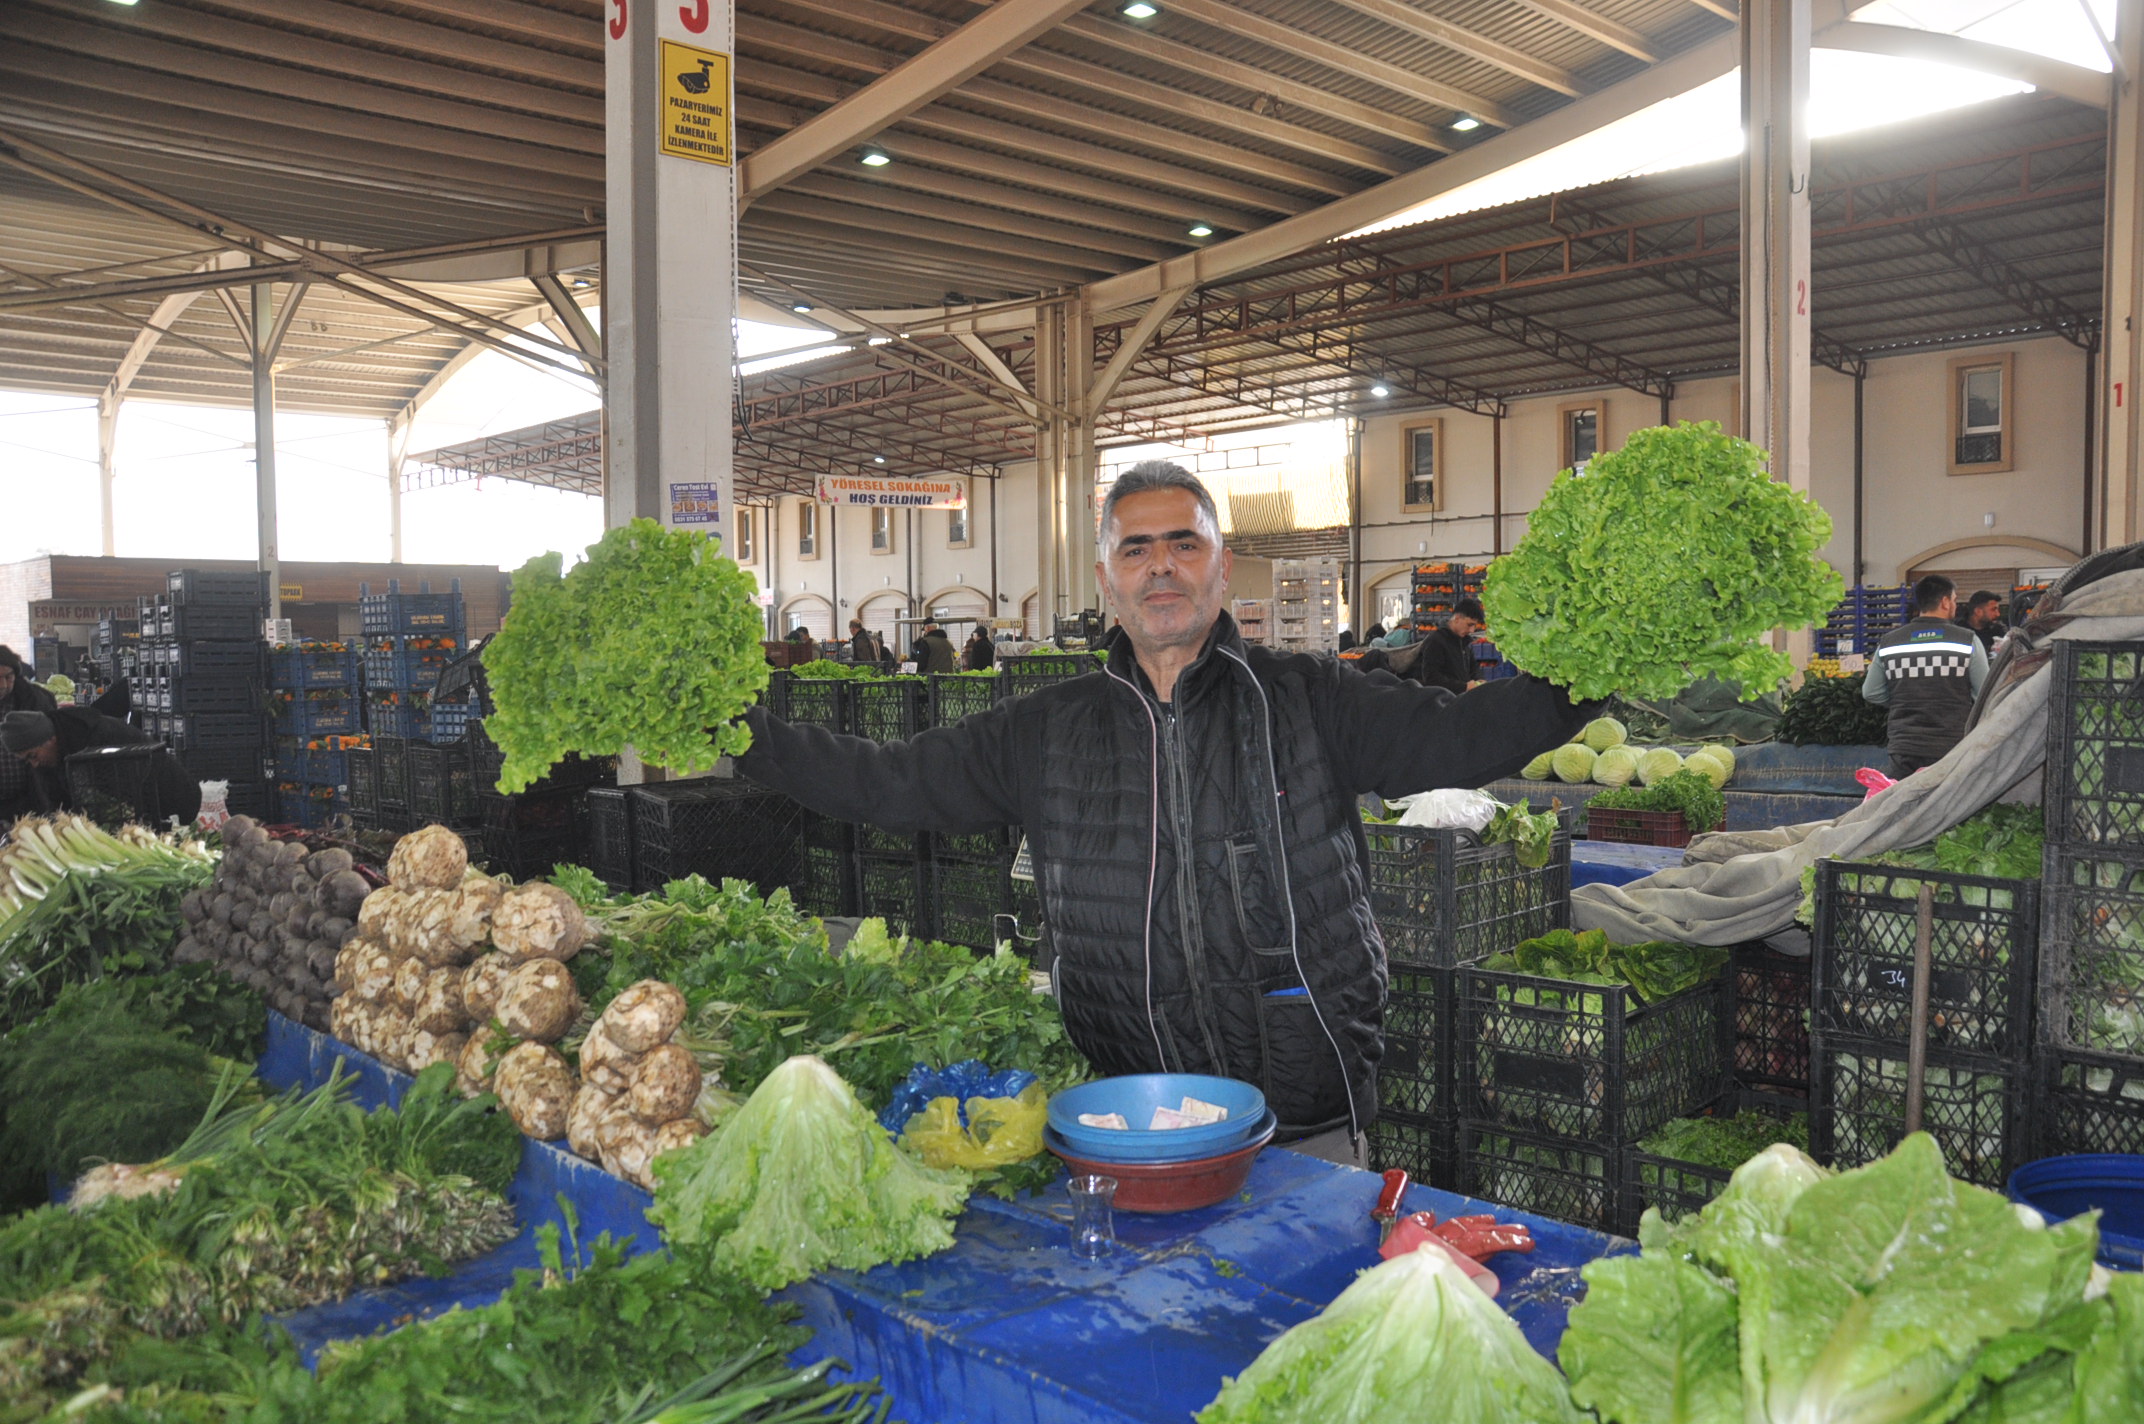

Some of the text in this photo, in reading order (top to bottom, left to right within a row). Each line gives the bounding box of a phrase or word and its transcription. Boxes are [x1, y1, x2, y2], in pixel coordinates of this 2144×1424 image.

[669, 96, 723, 117] PAZARYERİMİZ
[681, 112, 711, 127] 24 SAAT
[674, 124, 718, 142] KAMERA İLE
[668, 134, 724, 156] İZLENMEKTEDİR
[1797, 279, 1806, 316] 2
[2113, 382, 2123, 408] 1
[831, 477, 951, 493] YÖRESEL SOKAĞINA
[849, 493, 934, 506] HOŞ GELDİNİZ
[34, 606, 71, 618] ESNAF
[75, 606, 97, 620] ÇAY
[1881, 970, 1906, 988] 34
